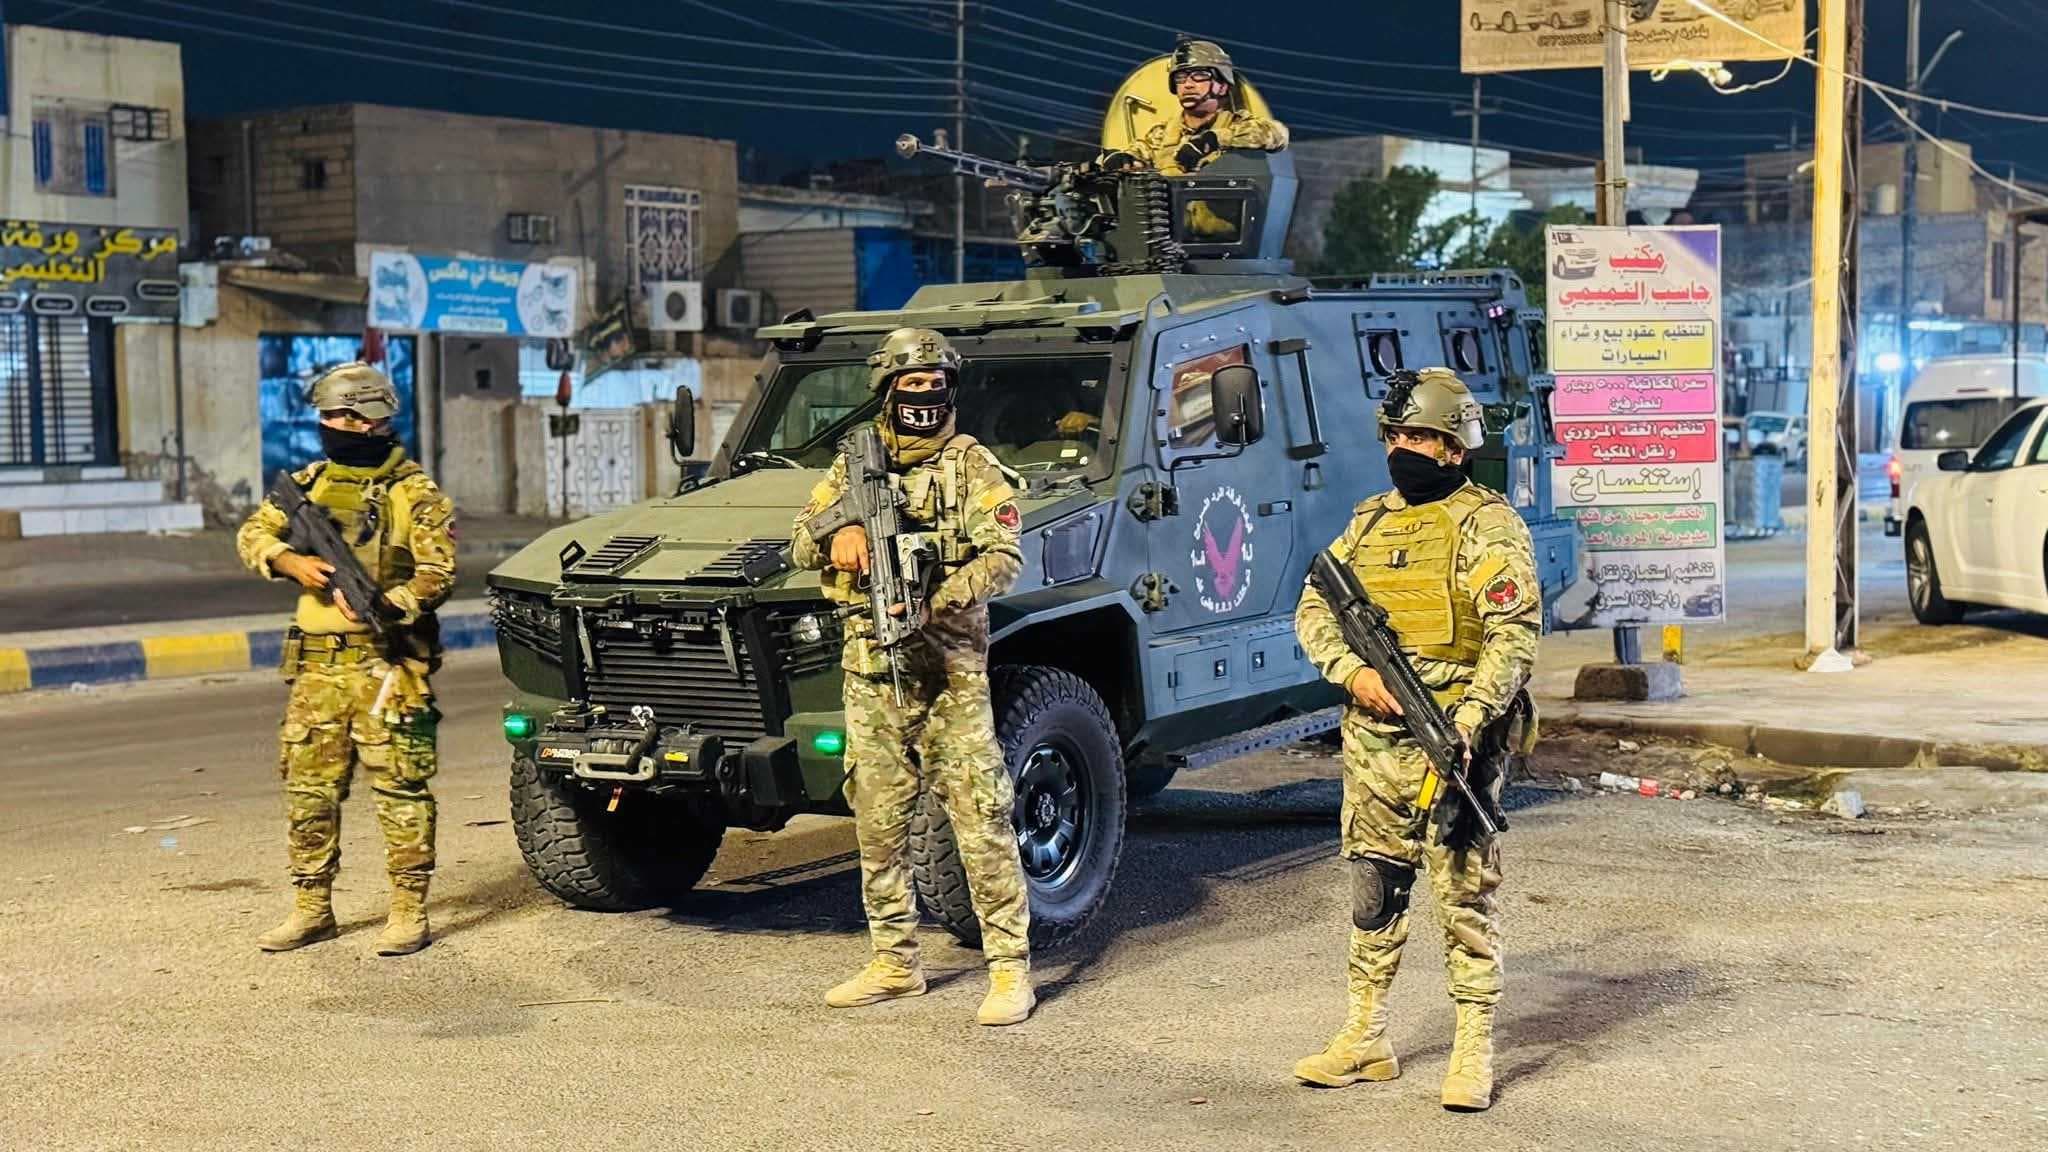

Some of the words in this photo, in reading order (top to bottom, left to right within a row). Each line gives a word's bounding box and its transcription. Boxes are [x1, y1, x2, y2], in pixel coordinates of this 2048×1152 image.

[94, 229, 177, 260] مركز
[1609, 244, 1666, 274] مكتب
[1559, 281, 1647, 309] التميمي
[1603, 327, 1623, 343] بيع
[1627, 324, 1656, 340] عقود
[1663, 324, 1705, 341] لتنظيم
[1602, 349, 1667, 364] السيارات
[1564, 378, 1594, 393] دينار
[1680, 379, 1707, 391] سعر
[1608, 397, 1663, 411] للطرفين
[902, 407, 938, 427] 5.11
[1563, 424, 1616, 442] المروري
[1620, 422, 1657, 436] العقد
[1660, 421, 1706, 439] تنظيم
[1592, 444, 1635, 462] الملكية
[1570, 467, 1702, 502] إستنساخ
[1604, 510, 1621, 524] من
[1664, 506, 1707, 523] المكتب
[1614, 527, 1653, 546] المرور
[1673, 561, 1715, 584] تنظيم
